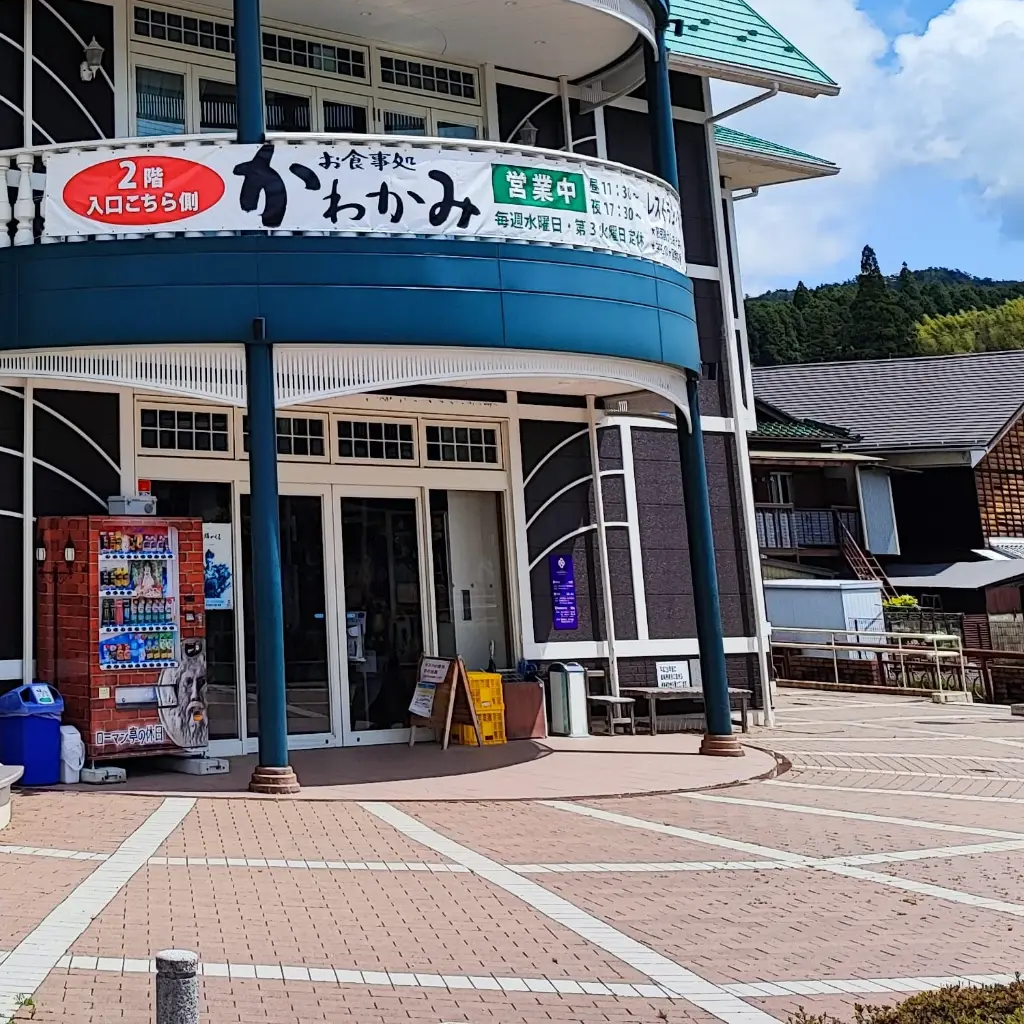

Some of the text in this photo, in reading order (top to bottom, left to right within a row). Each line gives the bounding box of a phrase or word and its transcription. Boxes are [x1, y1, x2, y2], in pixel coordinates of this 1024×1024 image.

[117, 160, 164, 190] 2階
[318, 149, 417, 171] お食事処
[233, 144, 481, 229] かわかみ
[506, 170, 576, 205] 営業中
[86, 191, 199, 216] 入口こちら側
